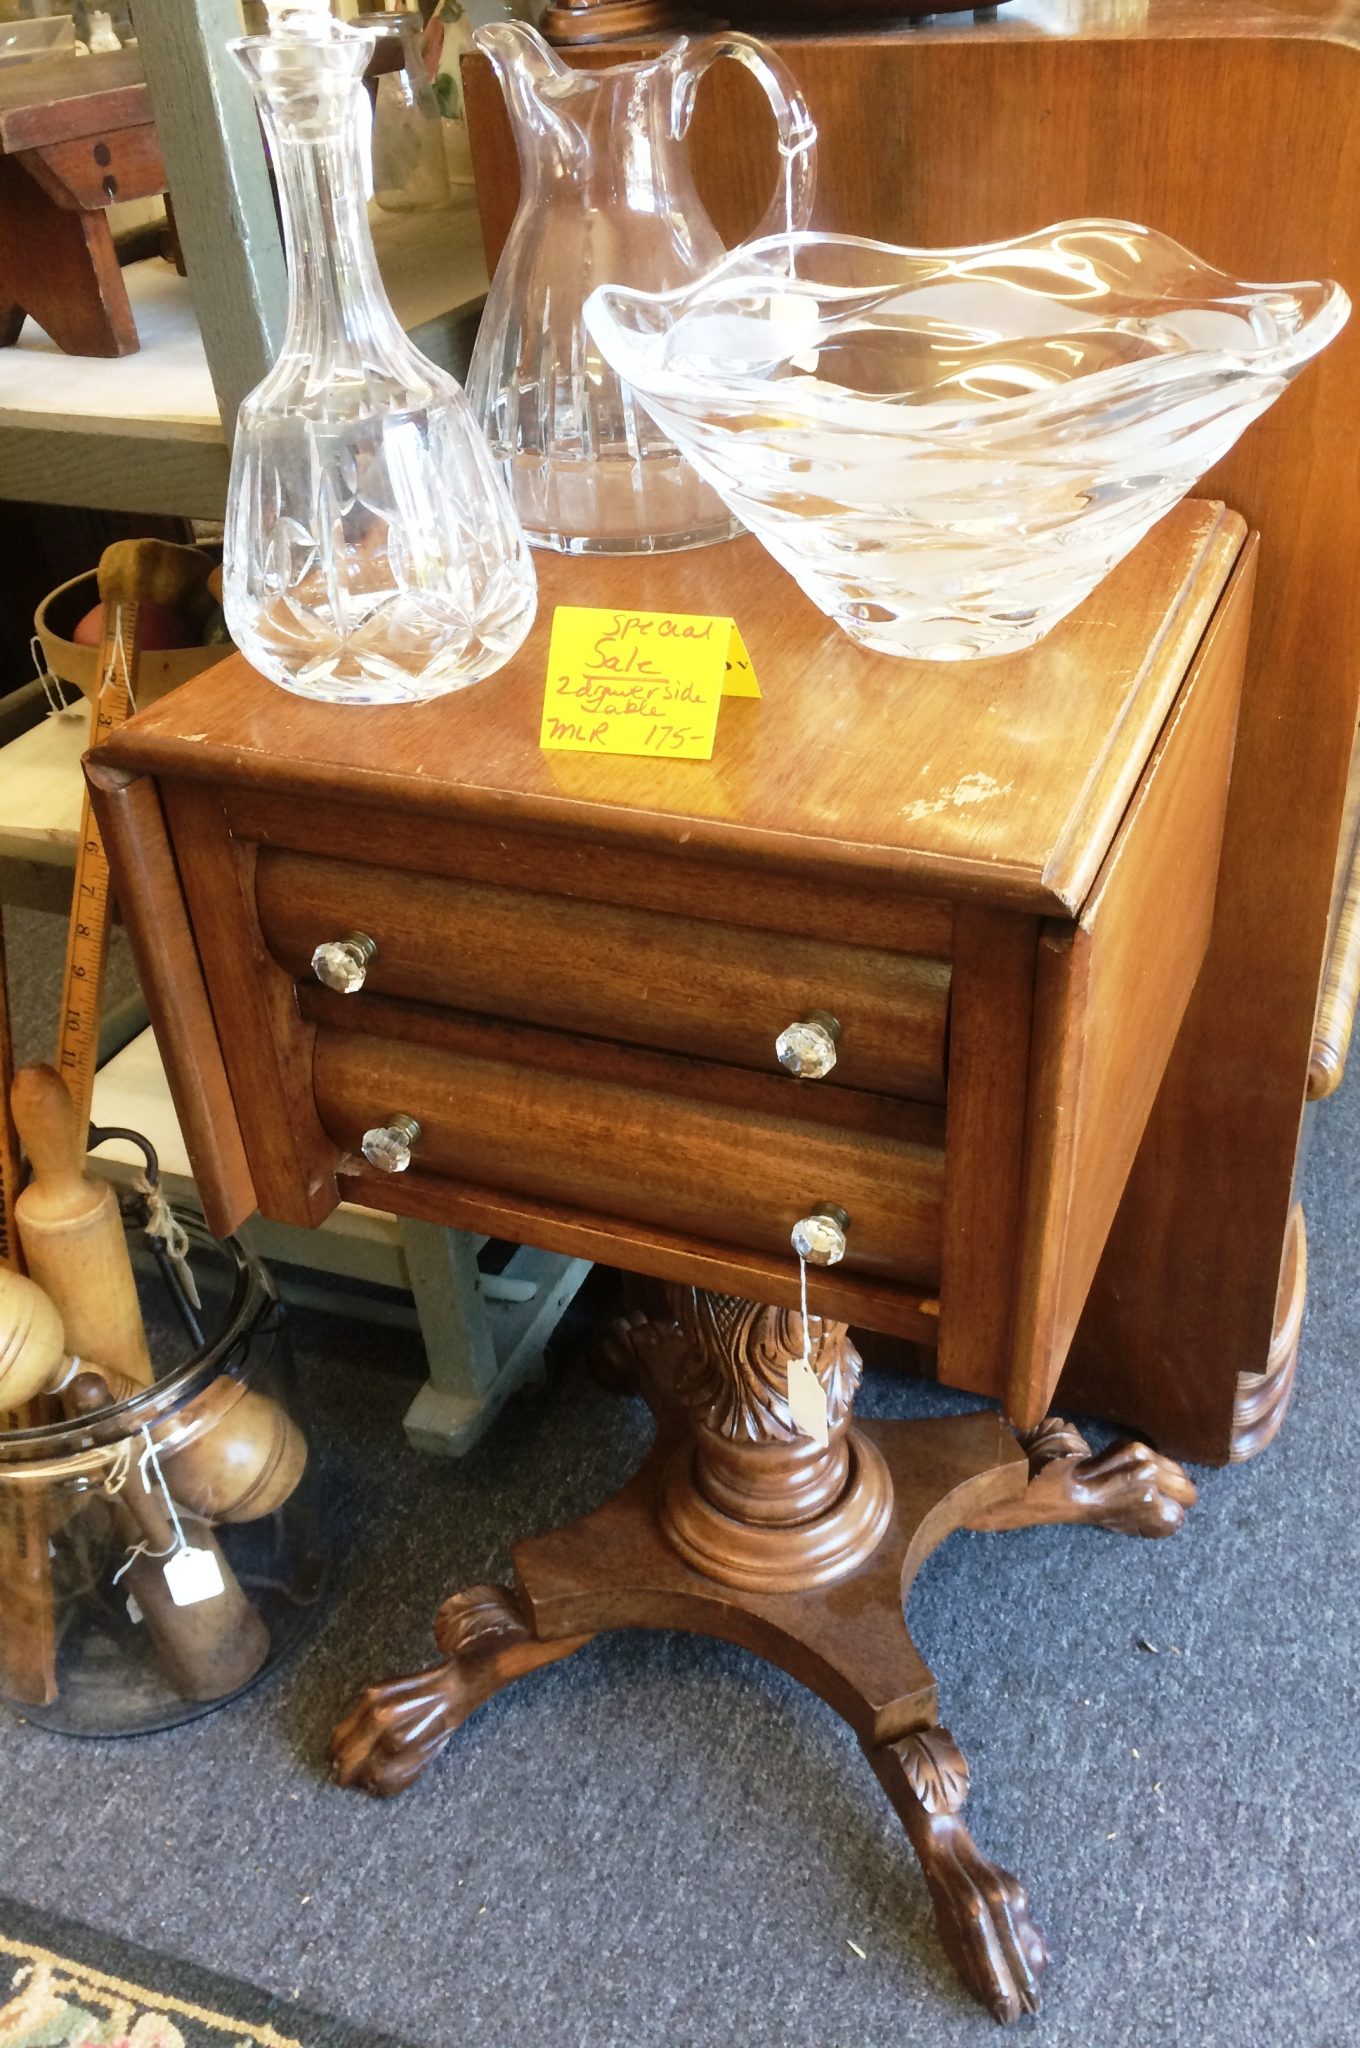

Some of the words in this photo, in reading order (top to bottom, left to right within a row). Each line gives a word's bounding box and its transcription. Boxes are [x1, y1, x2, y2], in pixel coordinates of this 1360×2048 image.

[602, 614, 714, 641] Special
[584, 637, 662, 675] Sale
[662, 680, 708, 704] side
[98, 712, 113, 726] 3
[85, 840, 99, 854] 6
[80, 883, 96, 896] 7
[76, 923, 91, 937] 8
[71, 964, 86, 978] 9
[66, 1009, 81, 1032] 10
[61, 1050, 76, 1069] 11
